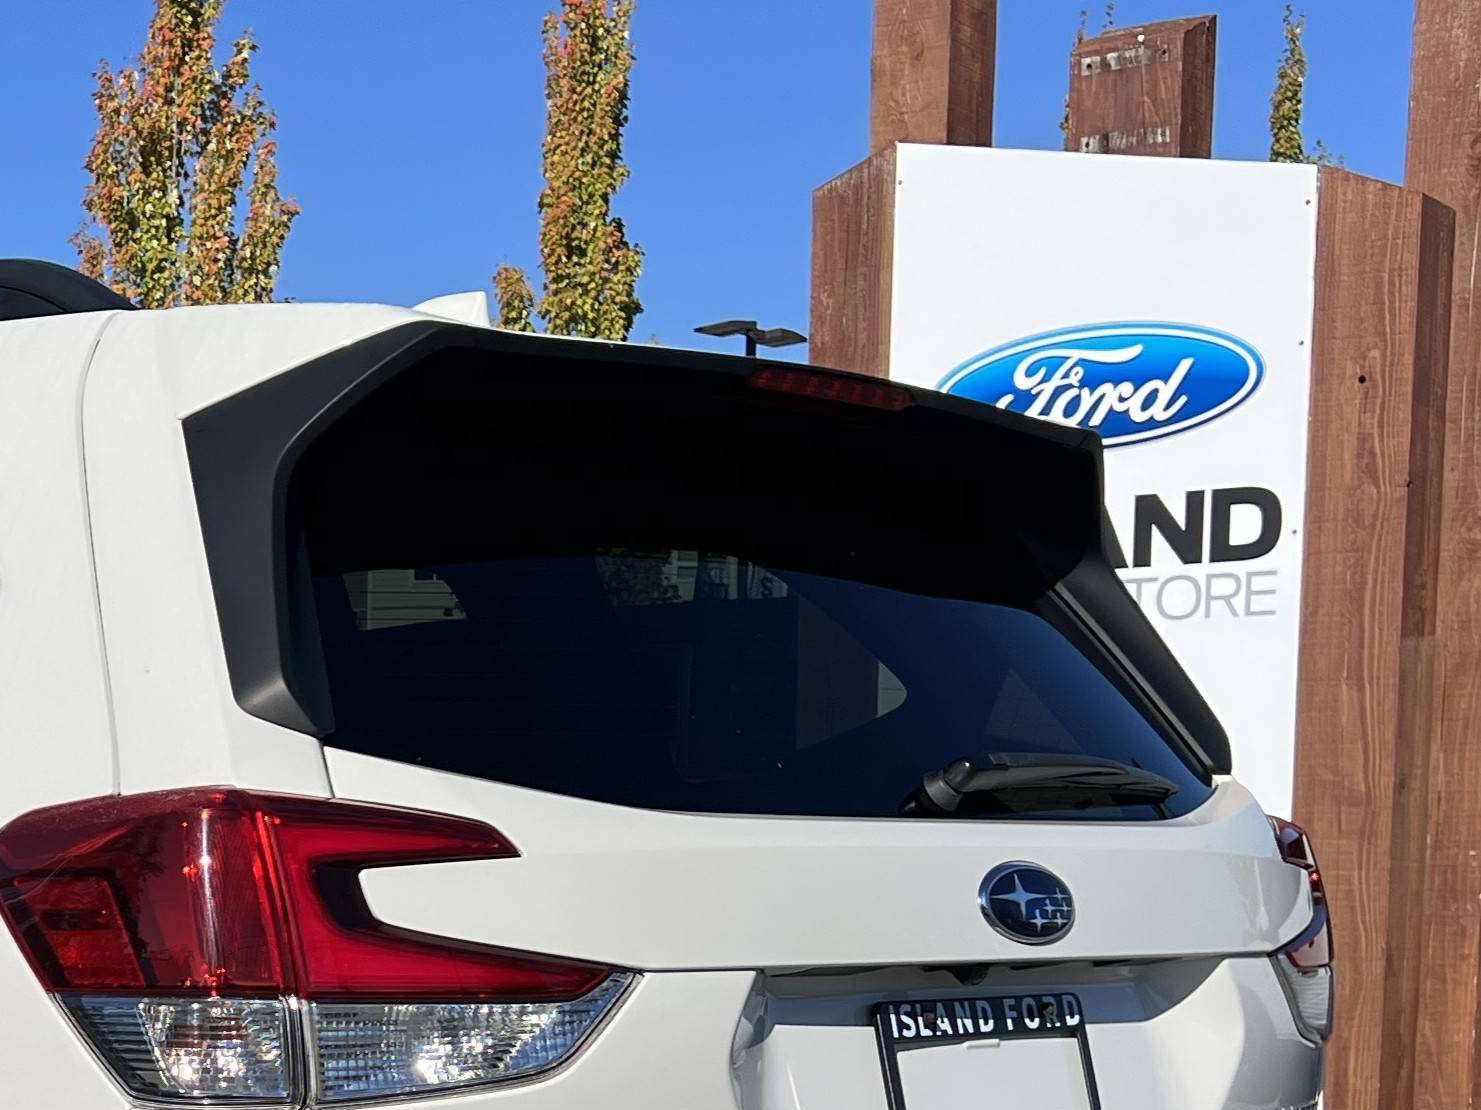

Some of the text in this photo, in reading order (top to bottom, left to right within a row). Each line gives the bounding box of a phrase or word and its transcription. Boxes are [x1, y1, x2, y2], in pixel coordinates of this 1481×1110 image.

[996, 344, 1195, 428] Ford
[888, 995, 1080, 1038] ISLAND FORD
